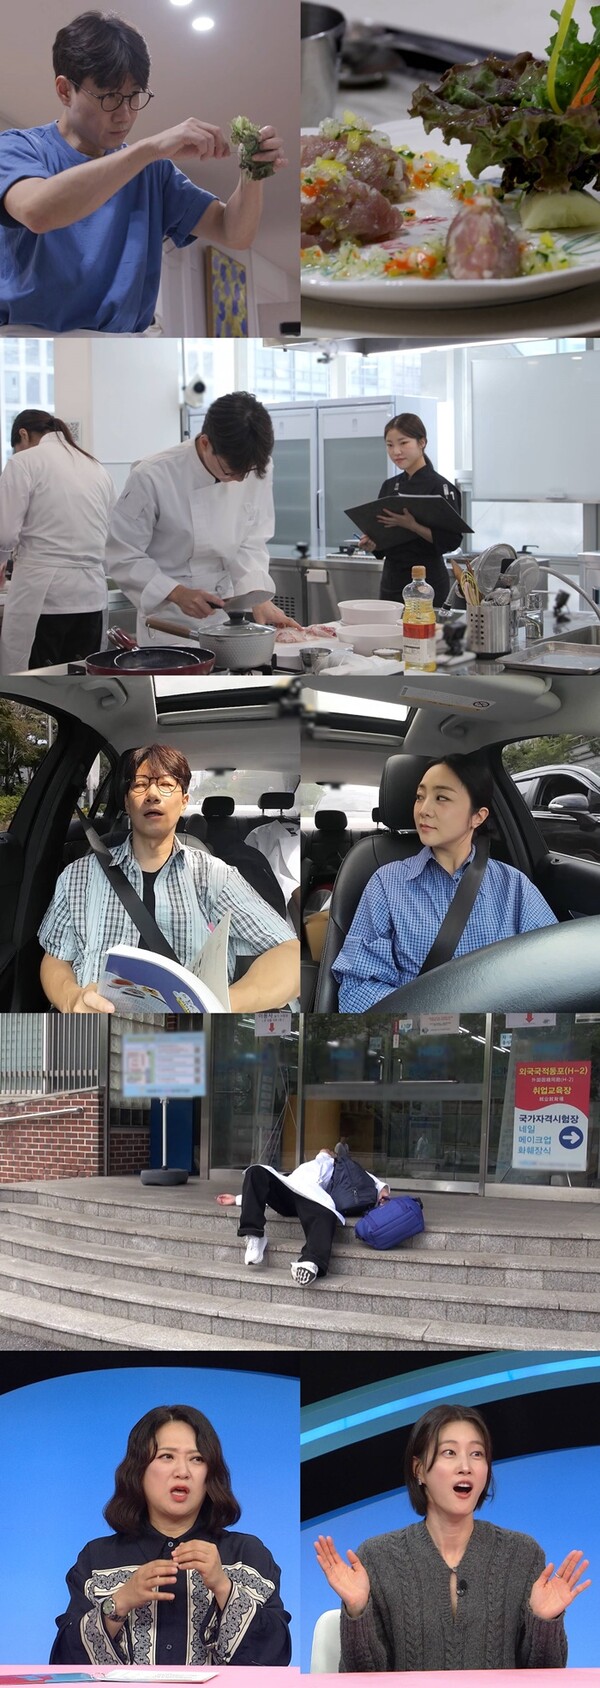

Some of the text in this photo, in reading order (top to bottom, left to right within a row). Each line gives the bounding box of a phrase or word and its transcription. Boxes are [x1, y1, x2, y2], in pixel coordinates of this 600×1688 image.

[519, 1066, 588, 1076] 외국국적동포(H-2)
[533, 1086, 572, 1095] 취업교육장
[519, 1114, 579, 1124] 국가자격시험장
[519, 1125, 536, 1134] 네일
[518, 1136, 552, 1145] 메이크업
[518, 1147, 551, 1156] 화훼장식
